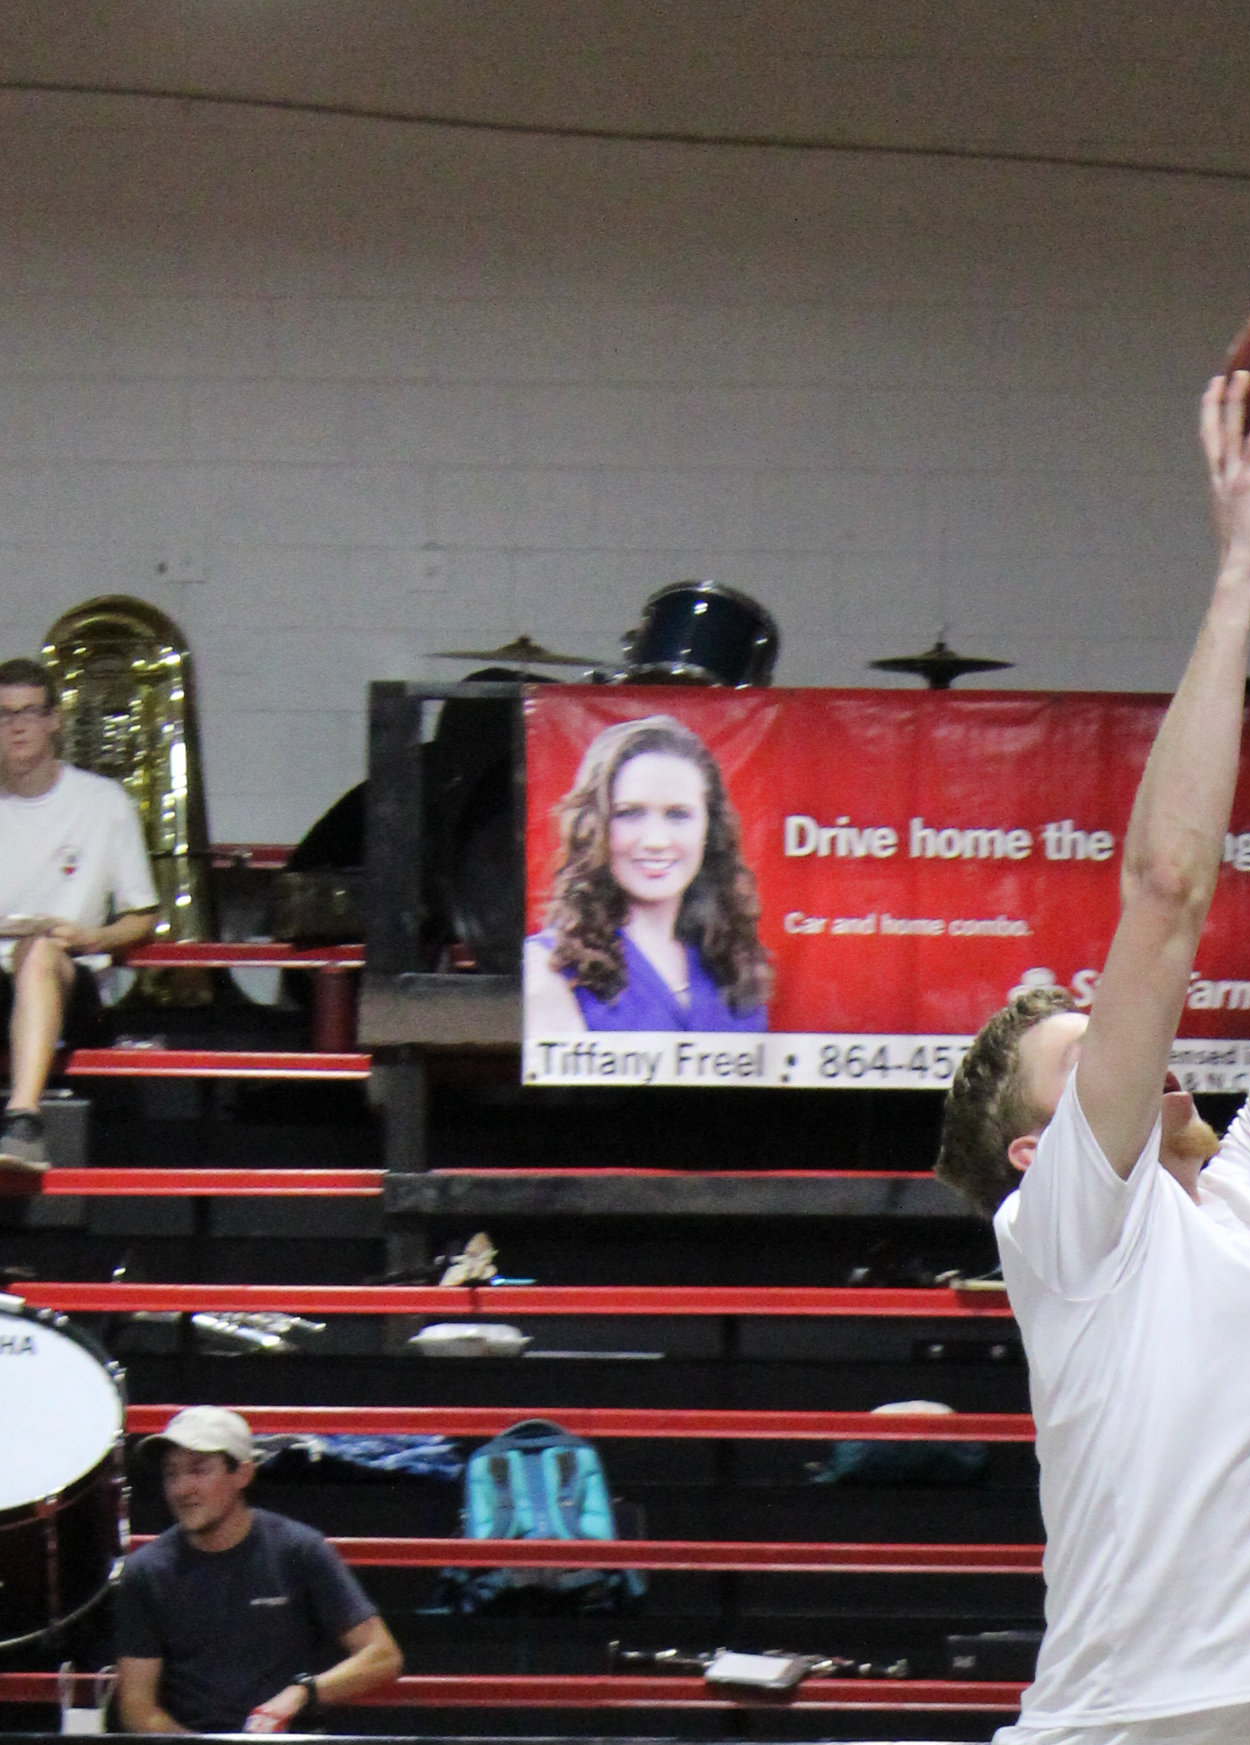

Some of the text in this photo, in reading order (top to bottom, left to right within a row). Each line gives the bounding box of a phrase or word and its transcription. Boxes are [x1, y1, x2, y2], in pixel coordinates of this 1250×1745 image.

[784, 814, 899, 858] Drive
[908, 816, 1033, 860] home
[1041, 819, 1115, 861] the
[784, 911, 828, 935] Car
[830, 913, 876, 936] and
[879, 913, 946, 936] home
[537, 1041, 968, 1085] Tiffany Freel 864-45
[0, 1335, 38, 1356] HA
